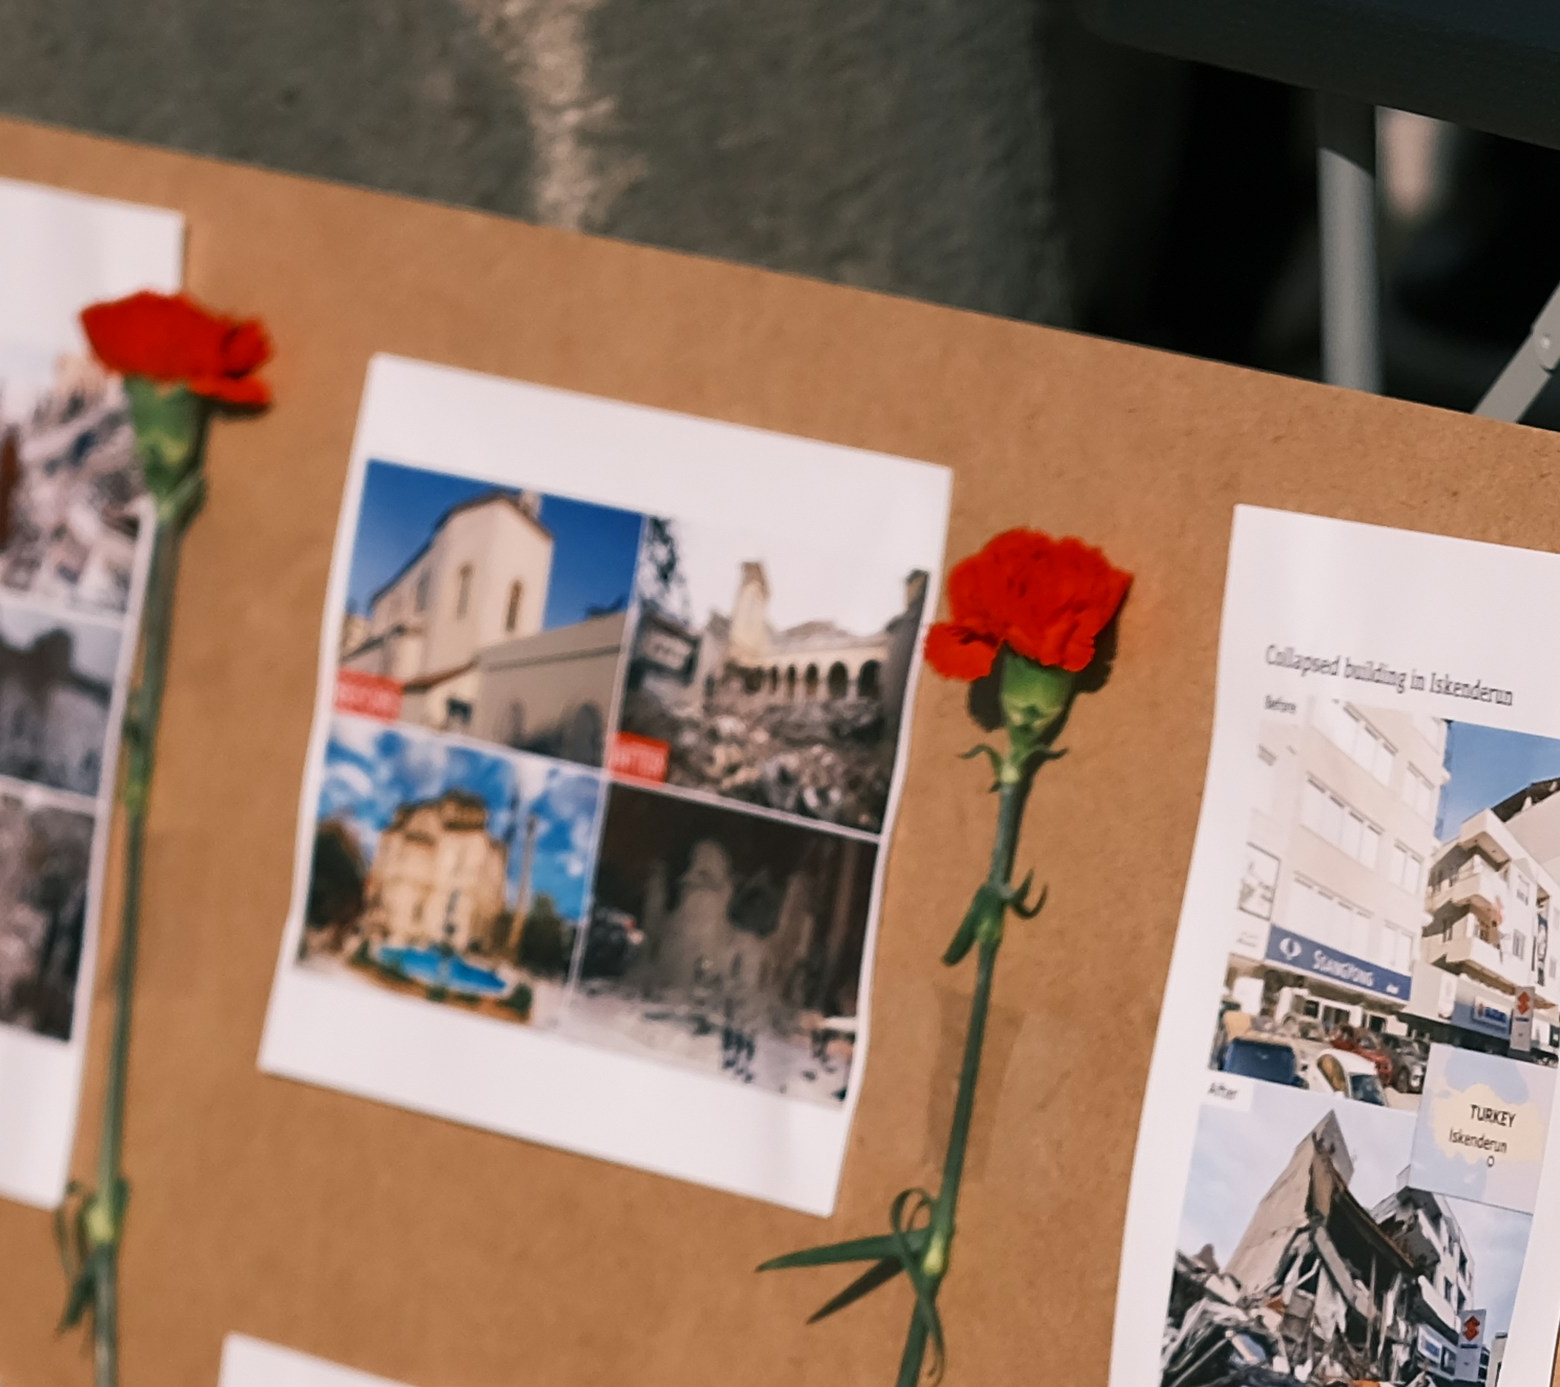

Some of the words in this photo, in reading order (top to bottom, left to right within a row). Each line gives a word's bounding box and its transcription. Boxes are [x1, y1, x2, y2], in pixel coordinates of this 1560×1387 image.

[1265, 643, 1340, 677] Collapsed
[1343, 656, 1407, 694] building
[1409, 668, 1426, 691] in
[1428, 671, 1514, 706] Iskenderun
[1206, 1081, 1240, 1101] After
[1469, 1103, 1517, 1129] TURKEY
[1448, 1130, 1508, 1154] Iskenderun
